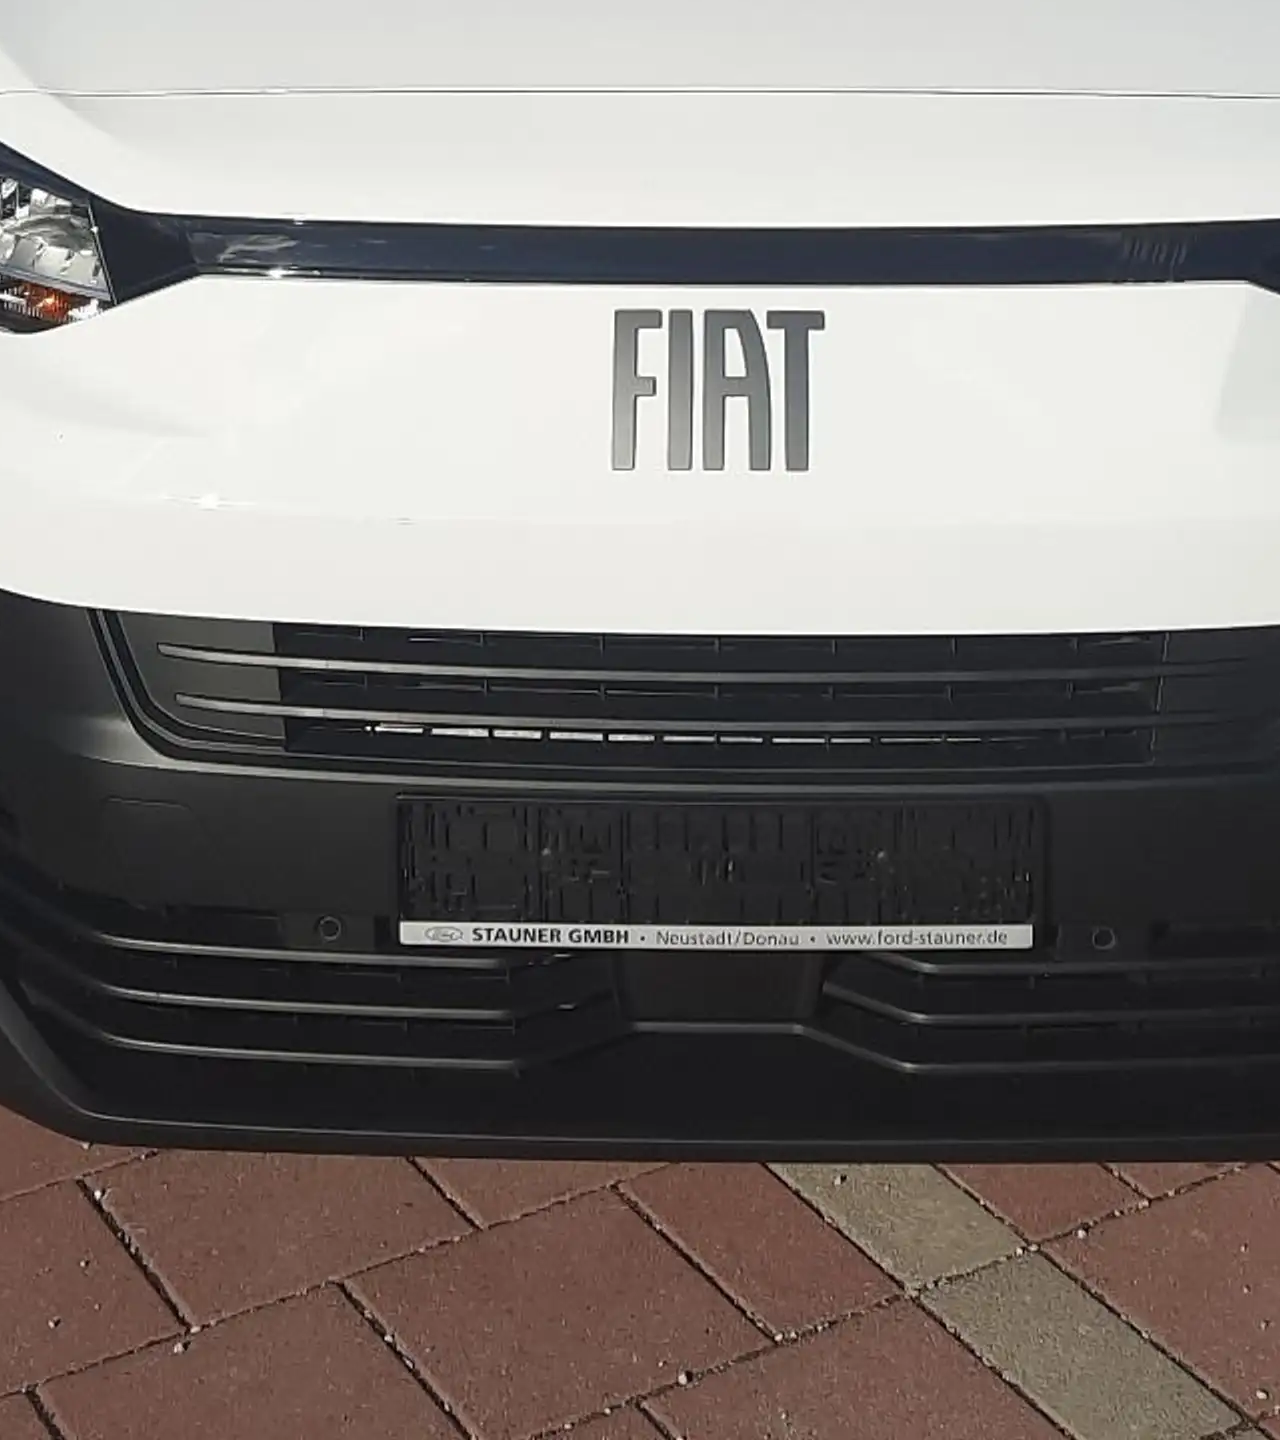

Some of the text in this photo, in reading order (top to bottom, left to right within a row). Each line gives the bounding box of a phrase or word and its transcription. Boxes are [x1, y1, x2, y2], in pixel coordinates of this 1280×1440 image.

[611, 308, 826, 471] FIAT
[472, 927, 561, 944] STAUNER
[569, 927, 629, 945] GMBH
[656, 929, 800, 948] Neustadt/Donau
[825, 929, 1008, 947] www.ford-stauner.de
